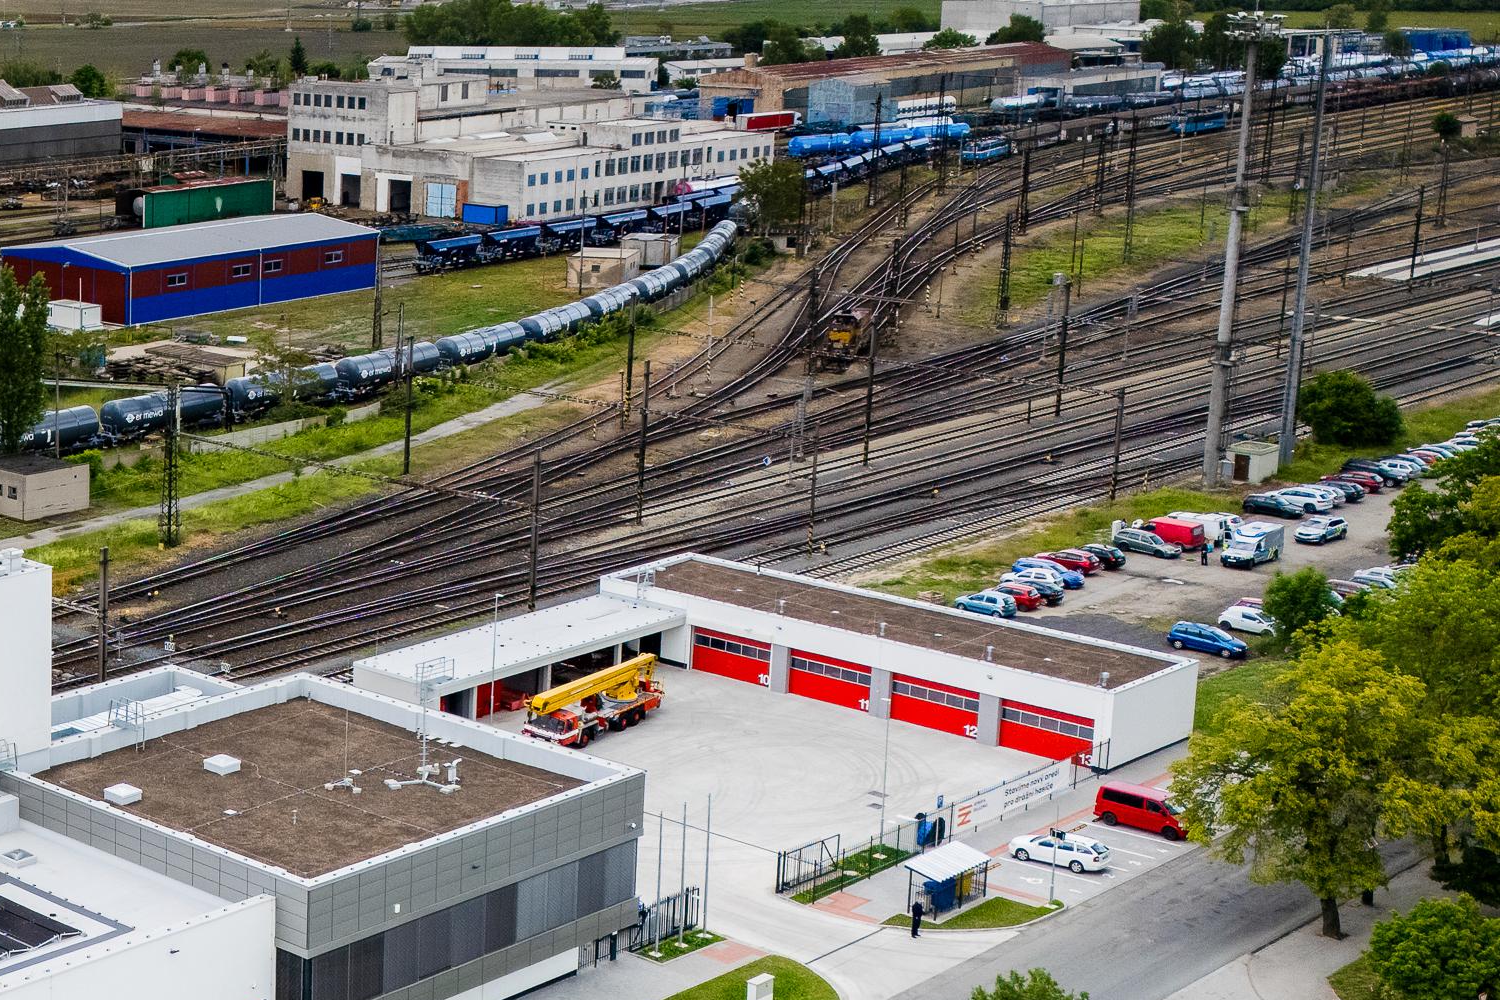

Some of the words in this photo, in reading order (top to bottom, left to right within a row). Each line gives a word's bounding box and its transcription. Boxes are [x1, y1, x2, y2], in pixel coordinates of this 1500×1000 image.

[758, 673, 770, 686] 10
[858, 698, 870, 711] 11
[963, 723, 978, 737] 12
[1078, 752, 1093, 767] 13
